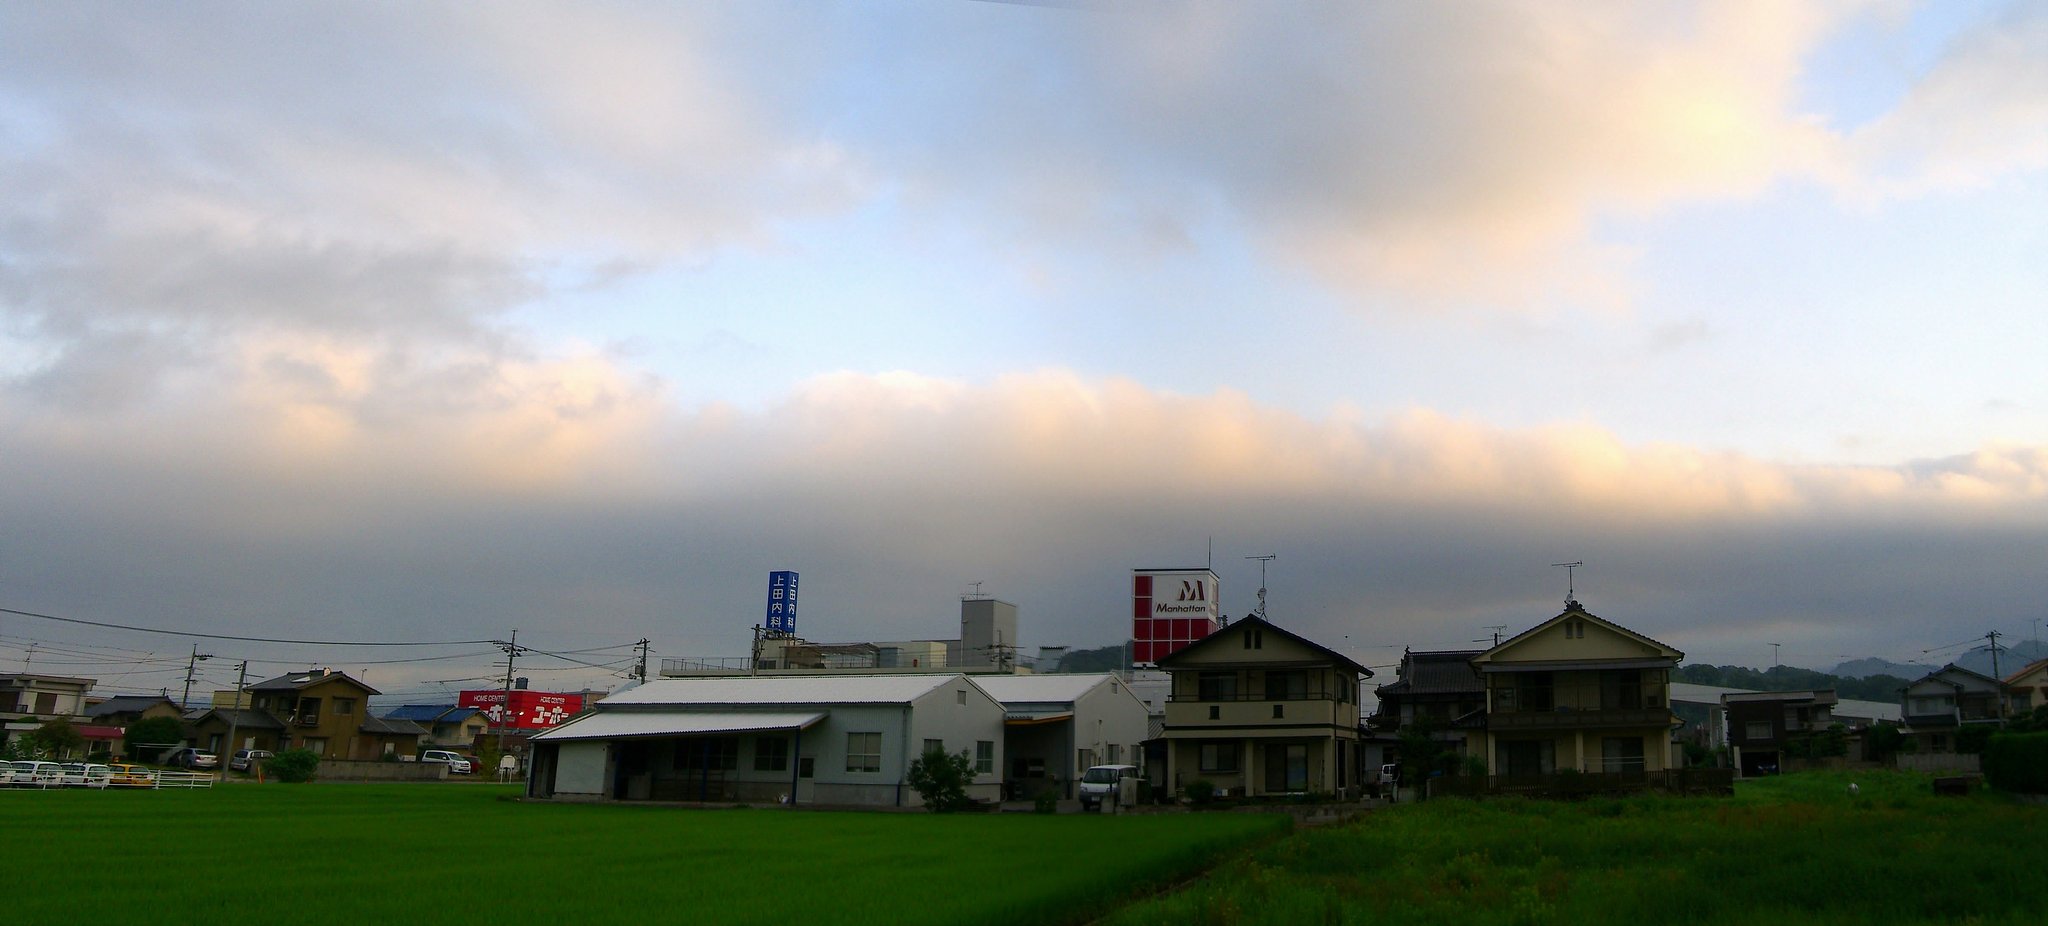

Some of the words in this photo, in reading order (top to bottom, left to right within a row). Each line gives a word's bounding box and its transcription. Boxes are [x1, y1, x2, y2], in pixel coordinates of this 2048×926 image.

[770, 575, 785, 628] 上田内科
[787, 576, 797, 629] 上田内科
[1155, 603, 1206, 613] Manhattan
[531, 706, 569, 724] ユーホー
